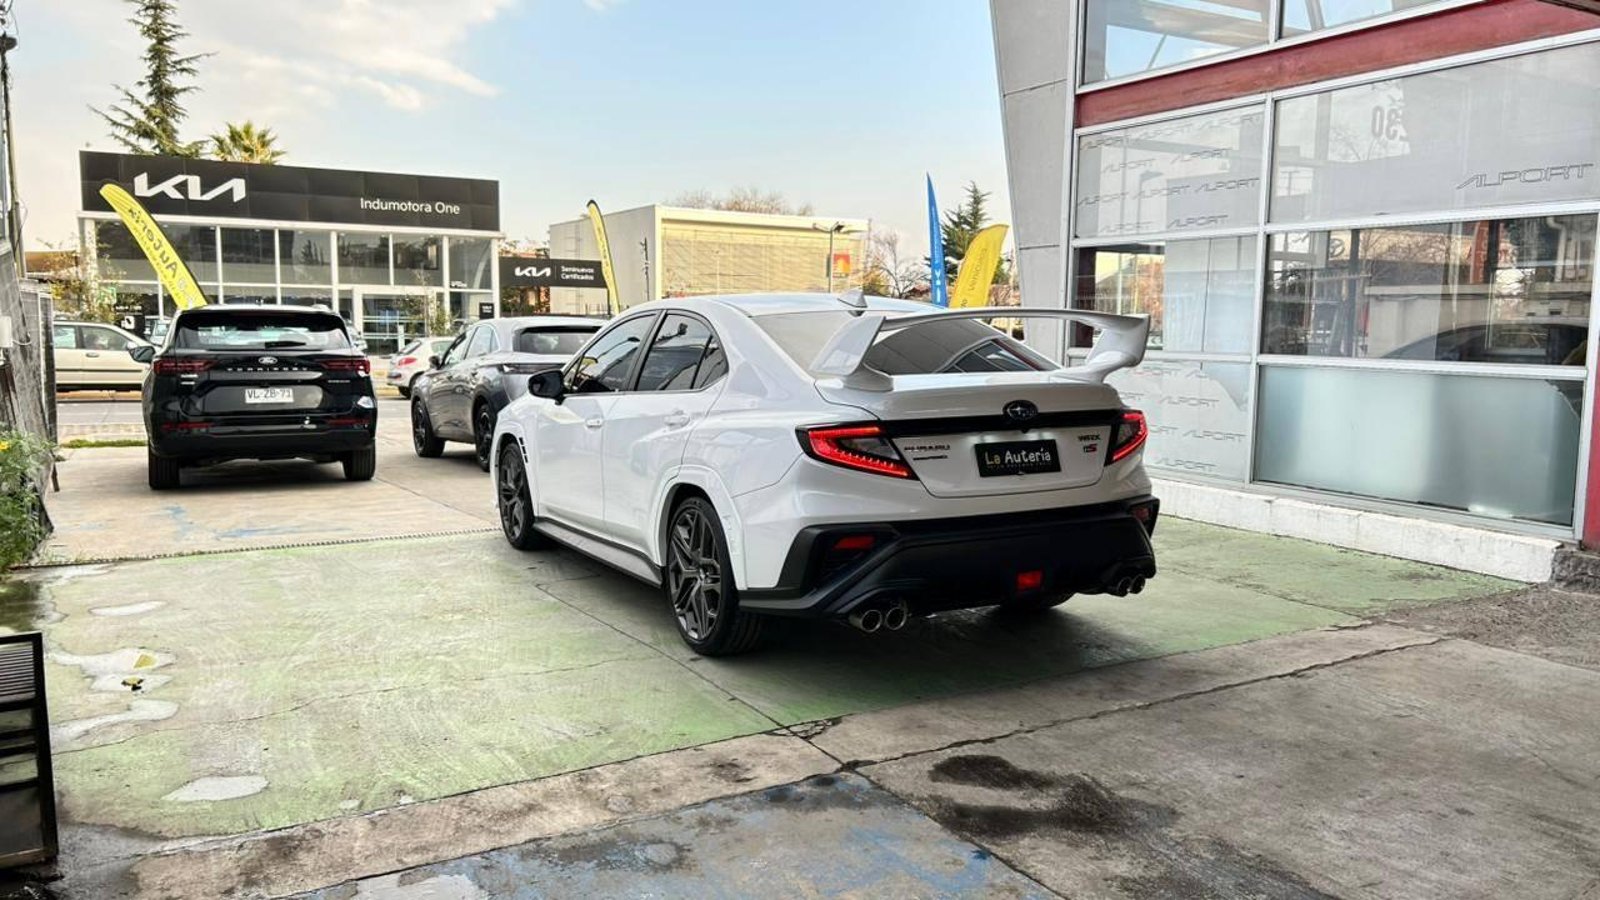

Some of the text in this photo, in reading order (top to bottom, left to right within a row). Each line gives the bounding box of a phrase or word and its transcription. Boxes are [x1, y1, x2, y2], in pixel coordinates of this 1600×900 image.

[1456, 162, 1594, 190] ALPORT
[133, 172, 246, 203] KIA
[1194, 177, 1260, 193] ALPORT
[360, 198, 461, 214] Indumotora One
[1166, 214, 1229, 230] ALPORT
[515, 267, 551, 277] KIA
[985, 448, 1051, 465] La Autería
